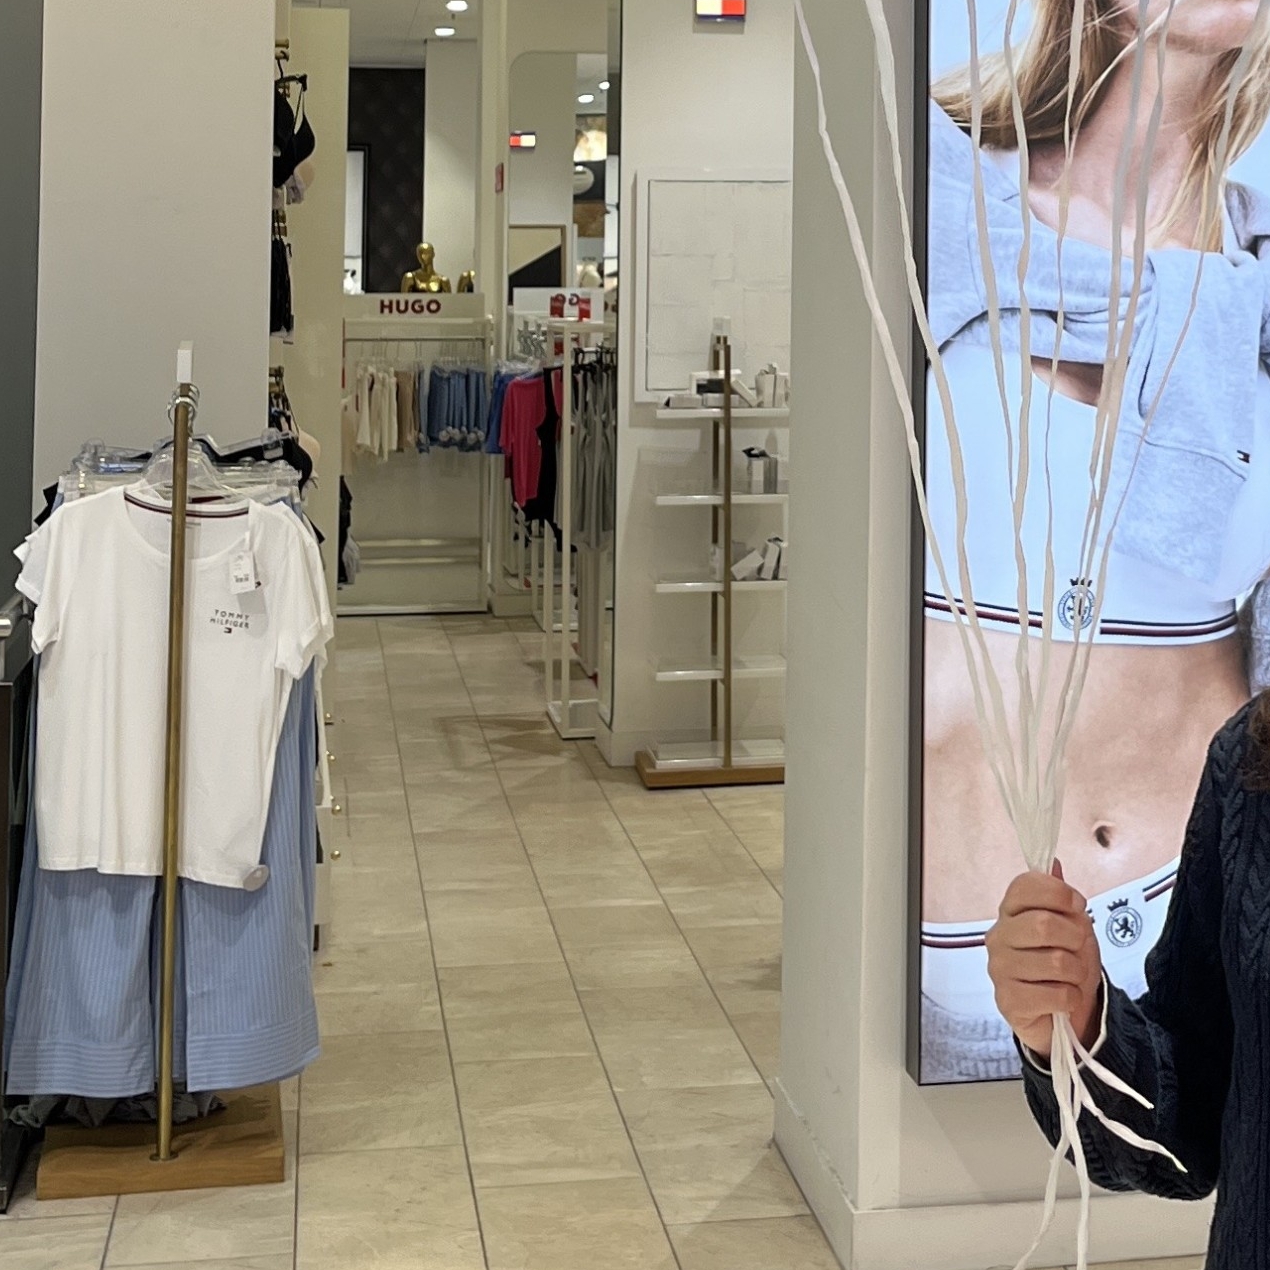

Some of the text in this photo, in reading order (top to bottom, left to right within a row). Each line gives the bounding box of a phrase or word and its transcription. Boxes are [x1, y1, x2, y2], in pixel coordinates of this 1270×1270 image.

[379, 299, 442, 314] HUGO
[214, 609, 250, 621] TOMMY
[209, 617, 250, 629] HILFIGER
